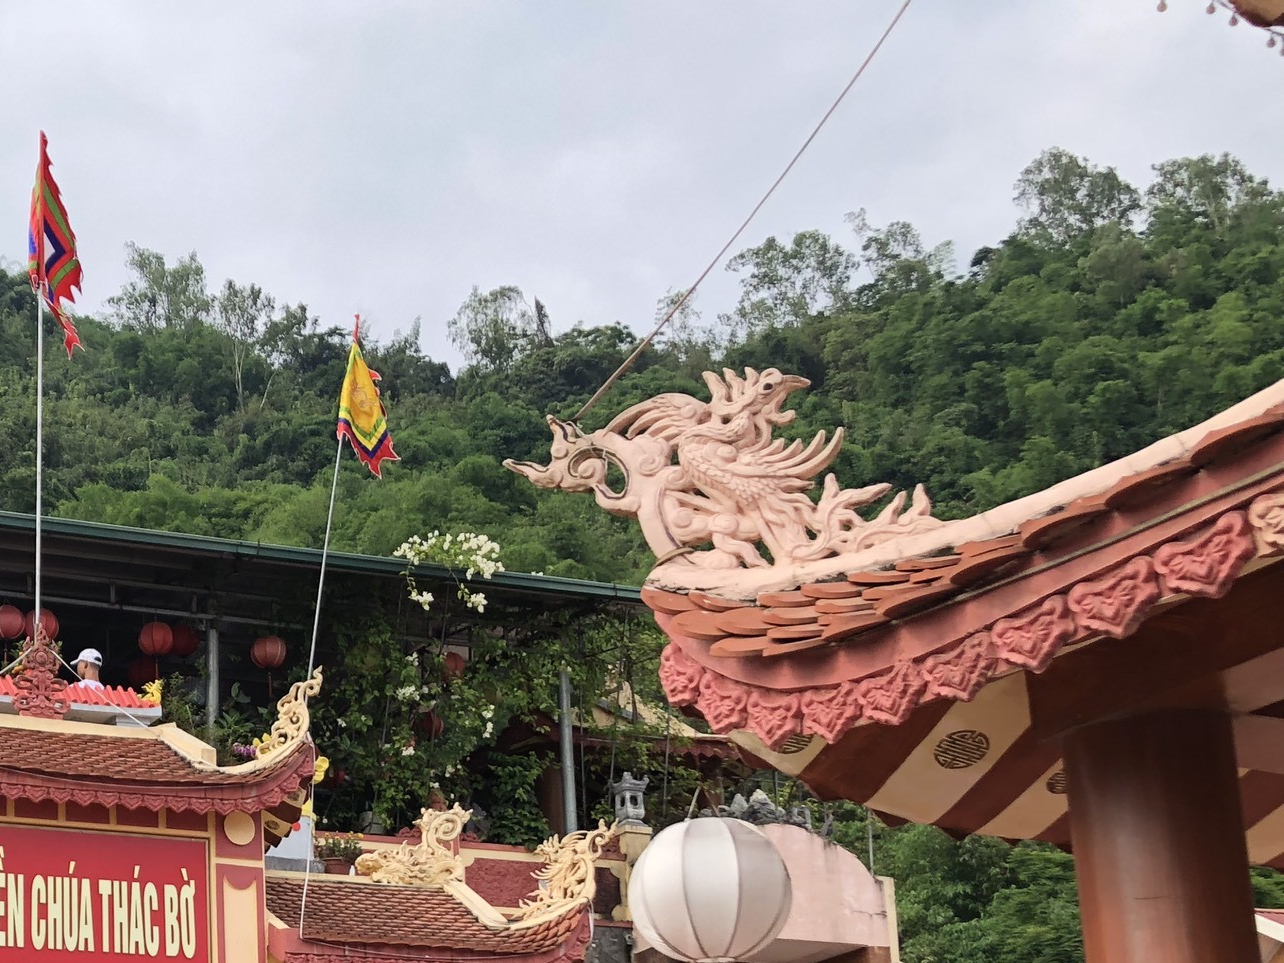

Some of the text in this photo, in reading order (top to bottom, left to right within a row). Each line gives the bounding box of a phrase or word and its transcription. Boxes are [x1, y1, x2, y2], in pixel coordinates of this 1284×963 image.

[31, 860, 95, 952] CHÚA
[98, 865, 160, 957] THÁC
[163, 867, 196, 959] BỜ
